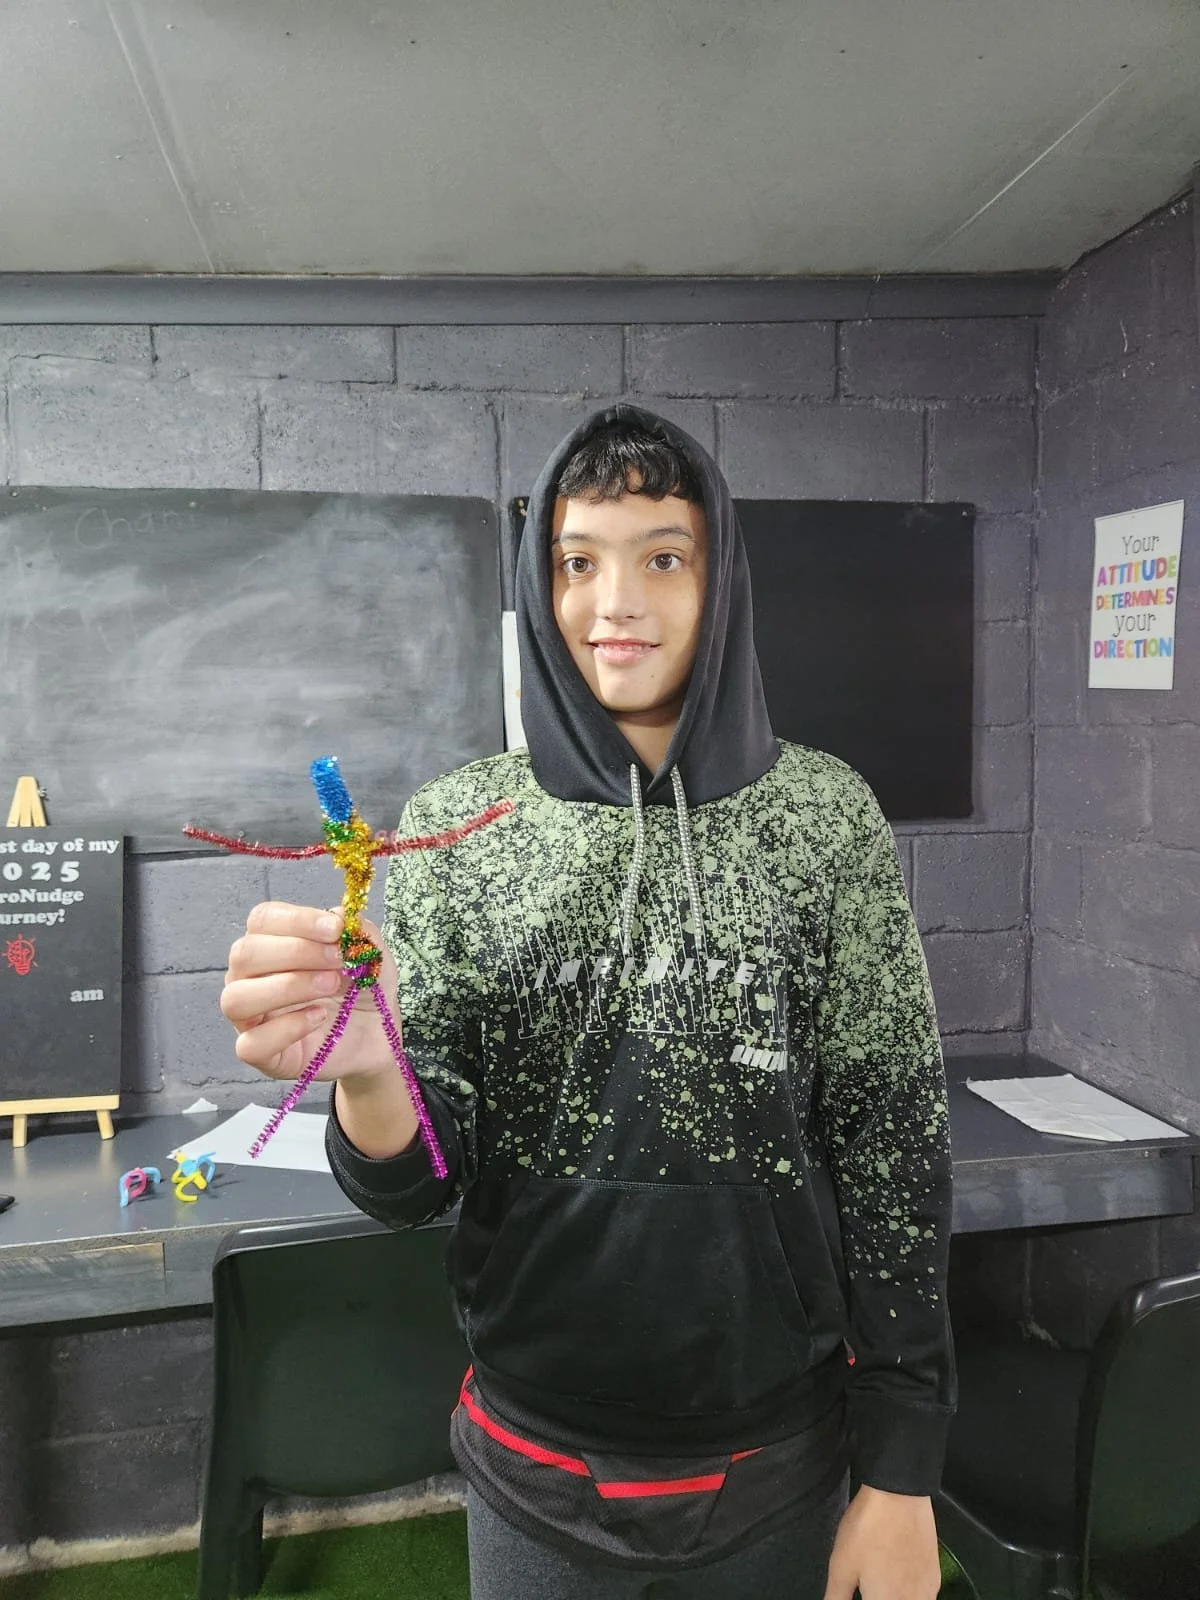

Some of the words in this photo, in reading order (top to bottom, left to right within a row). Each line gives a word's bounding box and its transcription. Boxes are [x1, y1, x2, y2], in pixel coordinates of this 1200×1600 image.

[1122, 535, 1160, 555] Your
[1097, 556, 1177, 588] ATTITUDE
[1096, 587, 1175, 611] DETERMINES
[1112, 613, 1157, 638] your
[1094, 637, 1172, 659] DIRECTION
[21, 839, 58, 855] day
[62, 838, 85, 852] of
[88, 839, 120, 854] my
[70, 989, 104, 1002] am
